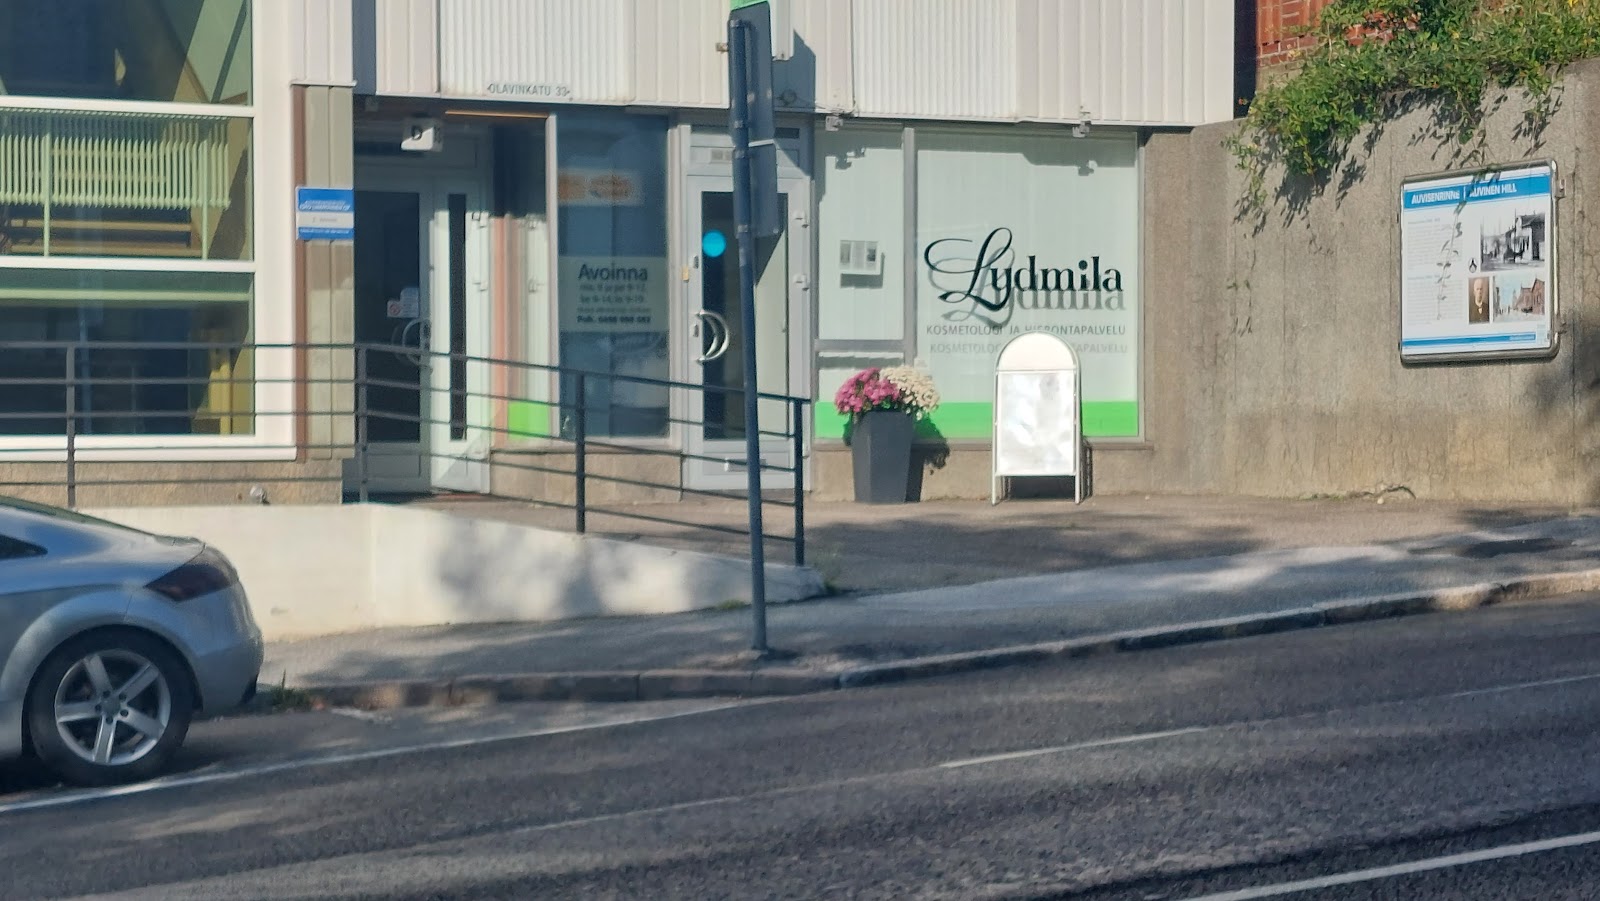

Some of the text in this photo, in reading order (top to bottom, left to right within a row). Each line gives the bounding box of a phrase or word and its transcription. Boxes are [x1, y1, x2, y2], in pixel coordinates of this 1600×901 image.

[489, 83, 567, 97] OLAVINKATU 33
[411, 125, 423, 141] D
[1411, 190, 1460, 204] AUVISENRINNE
[1501, 183, 1517, 194] HILL
[578, 263, 648, 281] Avoinna
[924, 227, 1123, 312] Lydmila
[926, 325, 1003, 336] KOSMETOLOGI
[1009, 325, 1020, 335] JA
